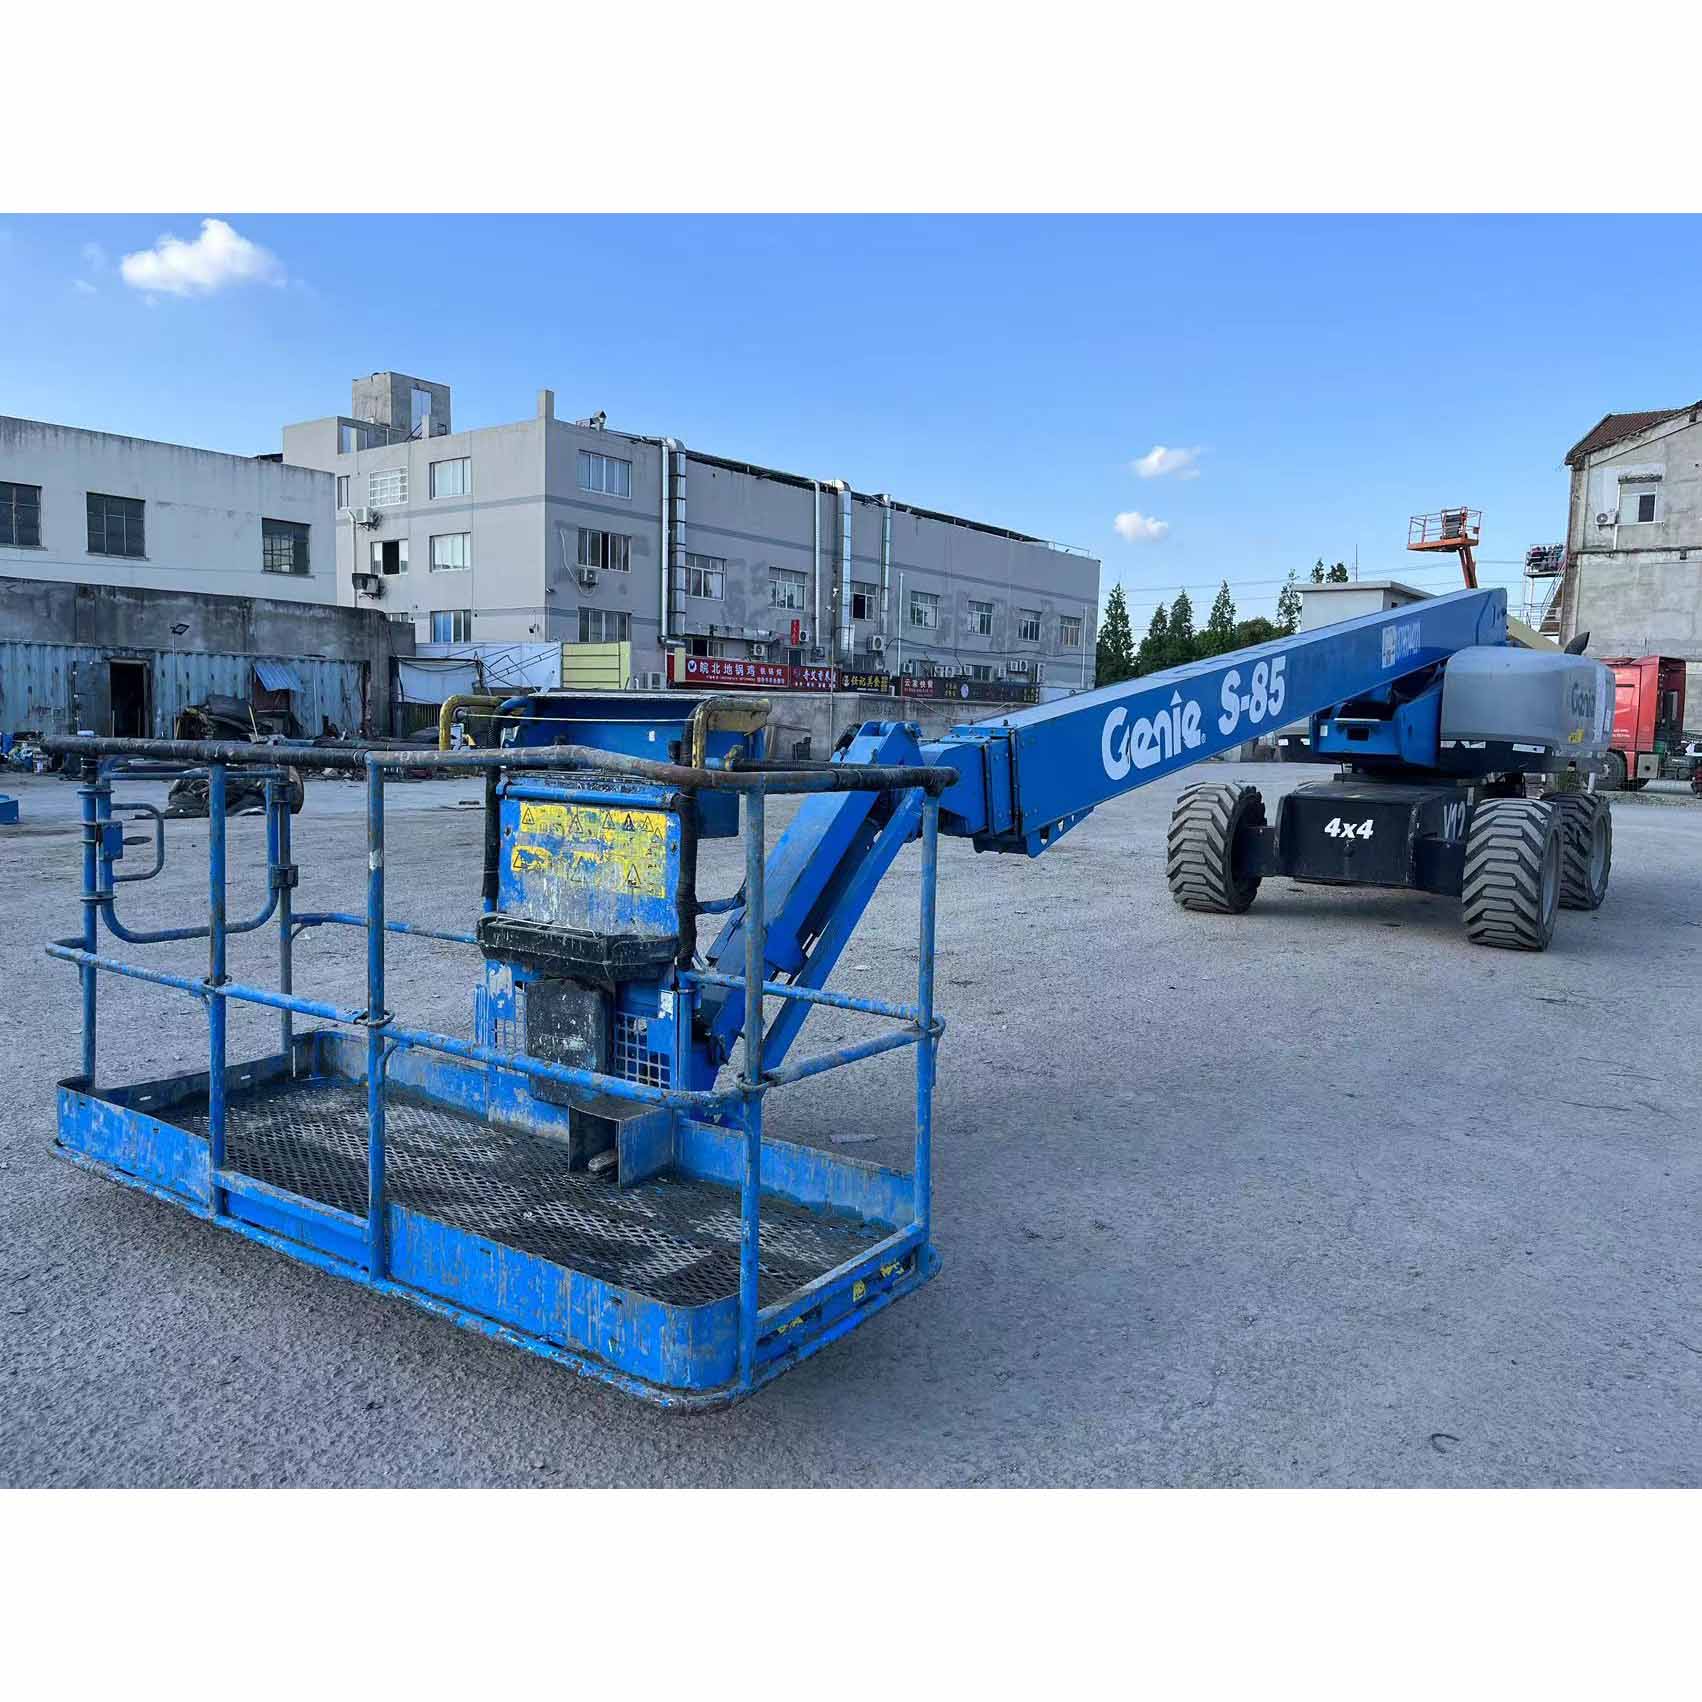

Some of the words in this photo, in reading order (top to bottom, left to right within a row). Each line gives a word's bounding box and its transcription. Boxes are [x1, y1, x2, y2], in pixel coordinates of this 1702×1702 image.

[1101, 689, 1201, 781] Genie
[1218, 656, 1287, 736] S-85
[1324, 817, 1374, 840] 4x4
